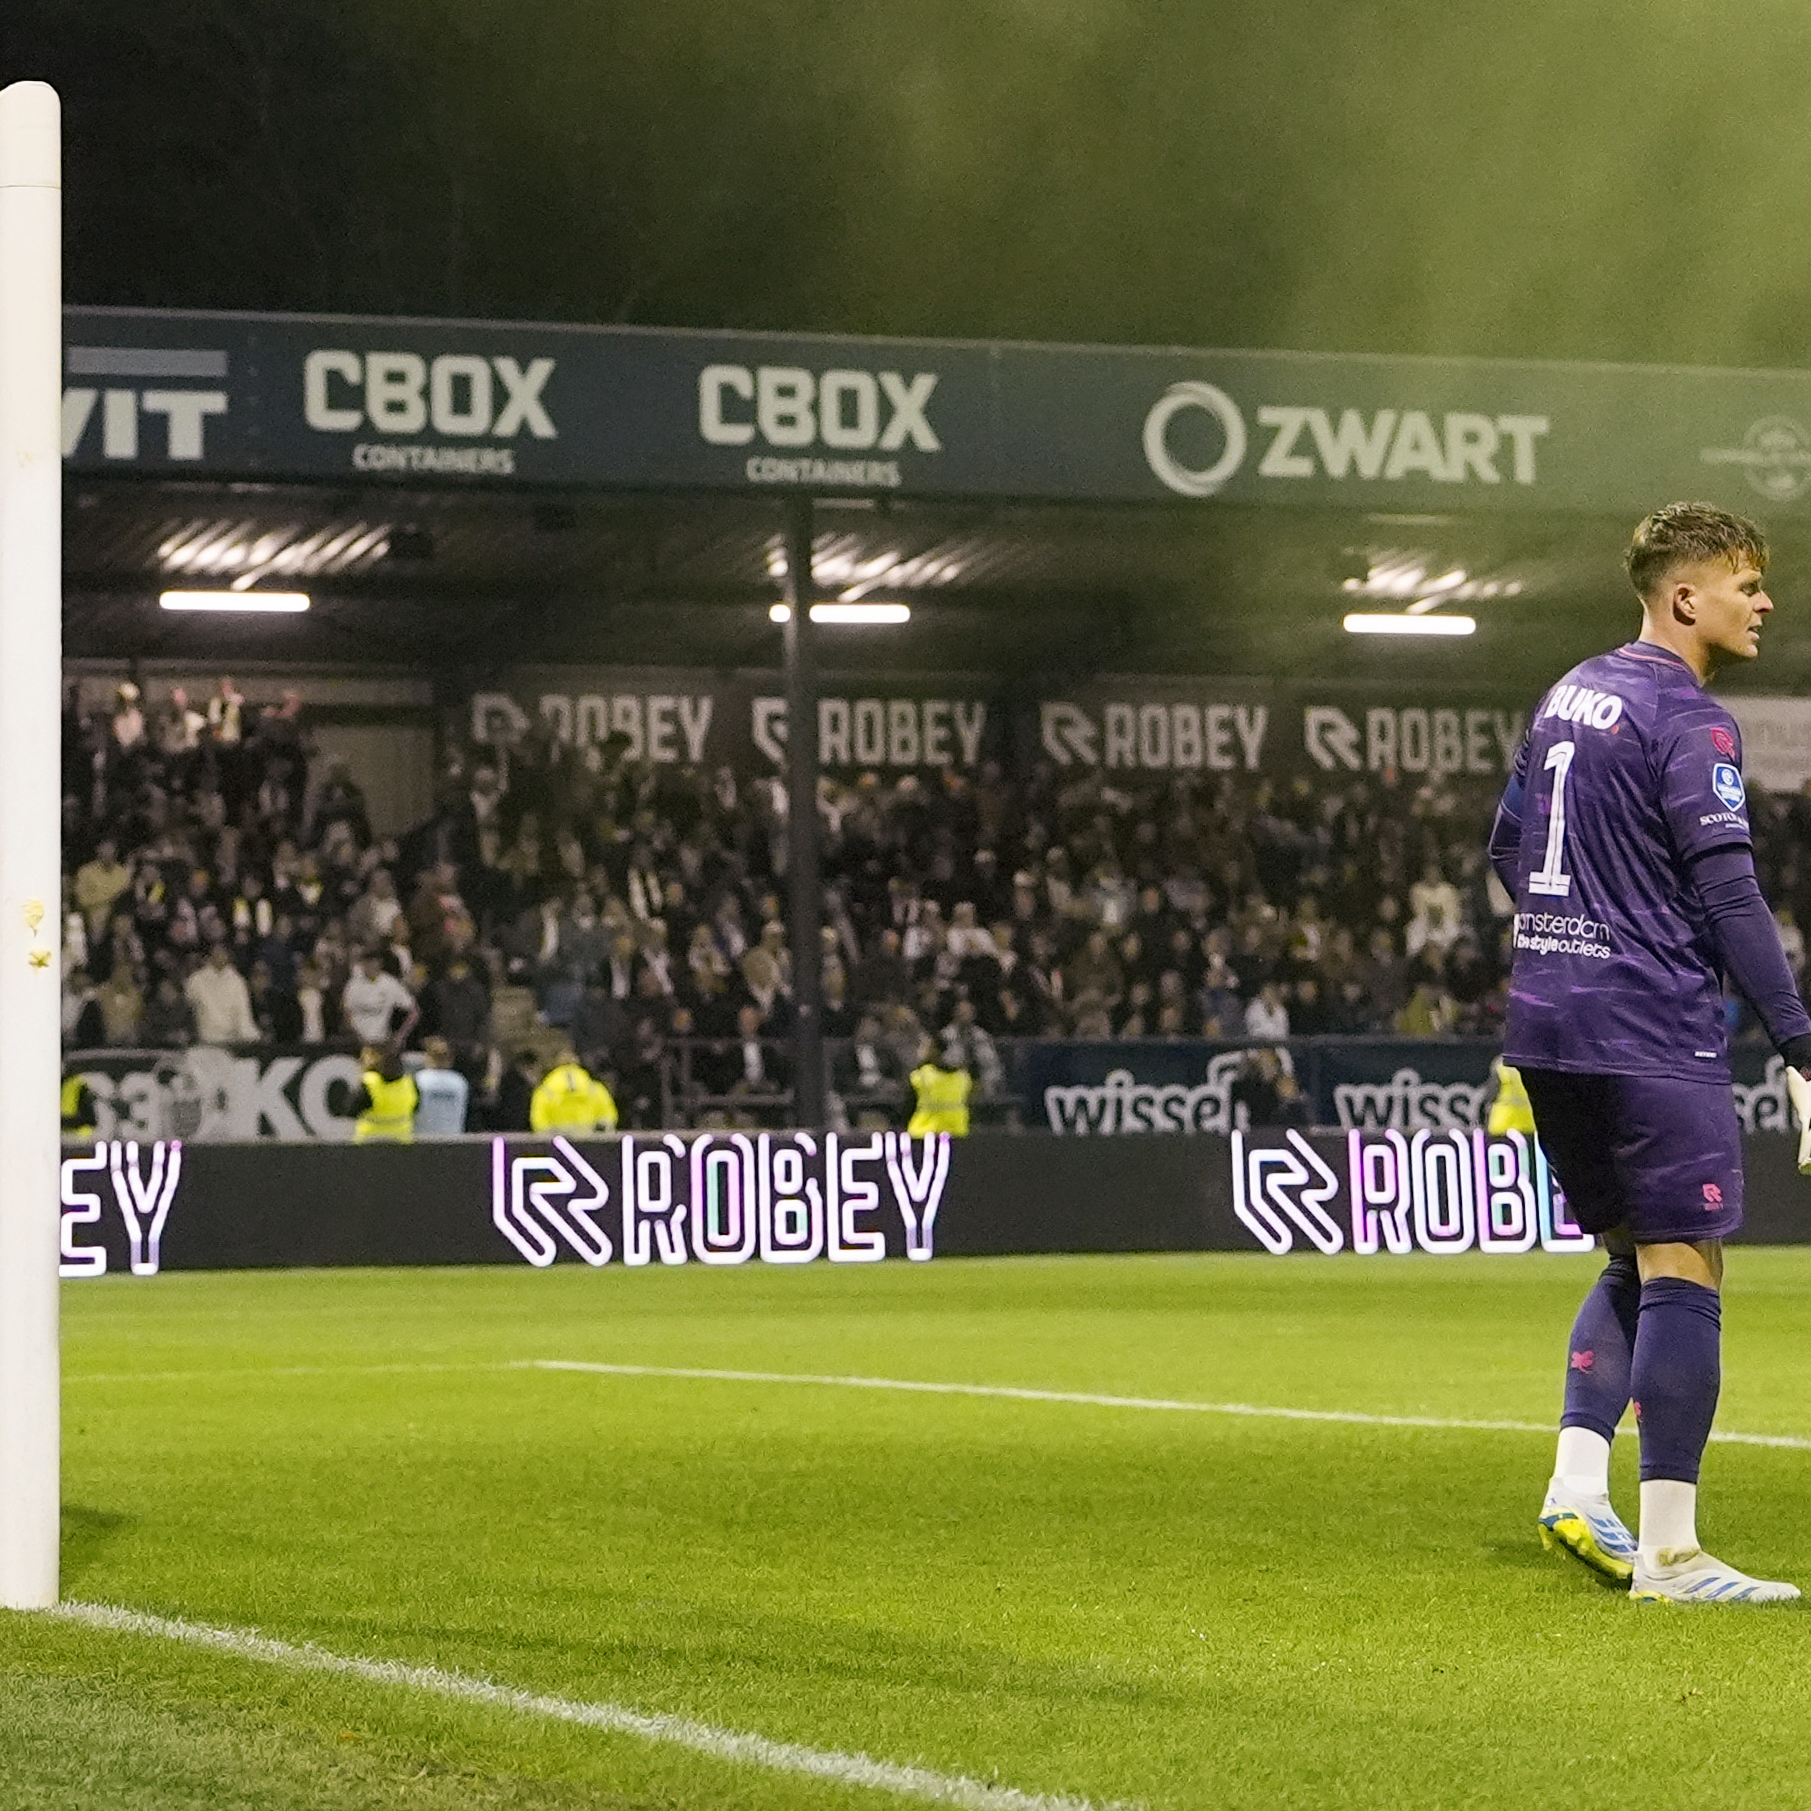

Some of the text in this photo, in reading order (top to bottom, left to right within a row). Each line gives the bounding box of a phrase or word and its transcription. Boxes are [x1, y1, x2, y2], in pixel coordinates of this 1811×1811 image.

[304, 349, 558, 440] CBOX
[698, 364, 942, 452] CBOX
[352, 443, 515, 475] CONTAINERS
[745, 454, 902, 486] CONTAINERS
[1256, 406, 1550, 485] ZWART
[816, 698, 985, 766] ROBEY
[1104, 701, 1270, 771] ROBEY
[1544, 685, 1623, 730] BUKO
[1528, 740, 1576, 898] 1
[622, 1131, 951, 1265] ROBEY
[1348, 1128, 1595, 1254] ROBE
